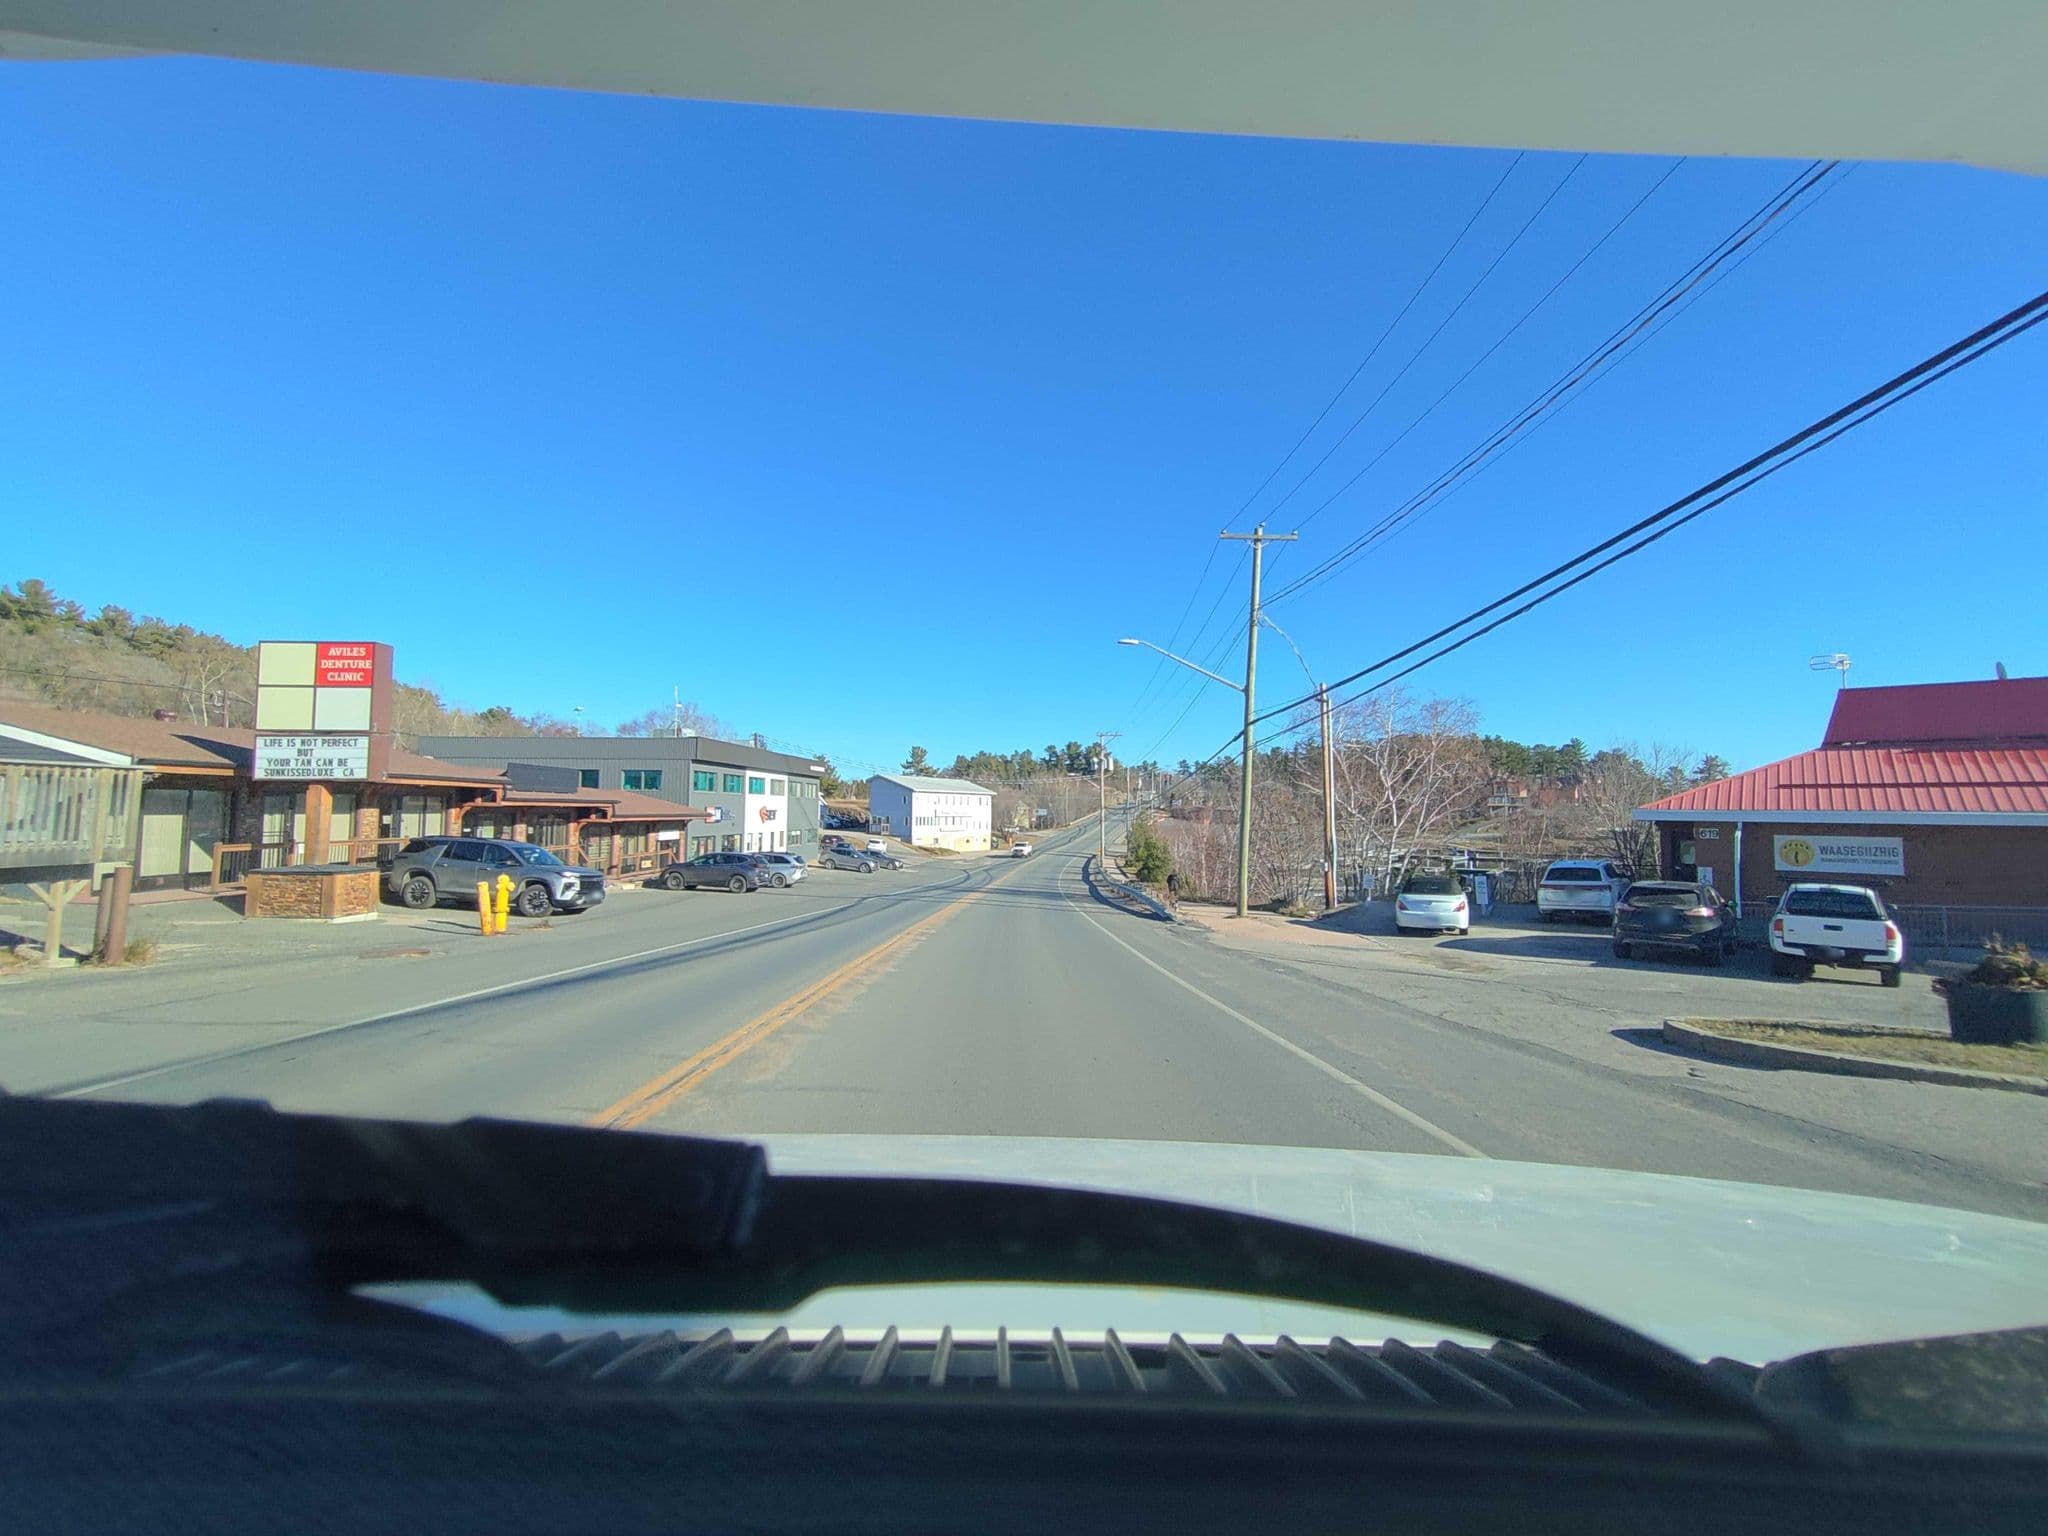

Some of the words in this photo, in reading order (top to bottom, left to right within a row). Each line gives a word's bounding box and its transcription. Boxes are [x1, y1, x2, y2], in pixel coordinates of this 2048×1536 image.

[328, 647, 366, 657] AVILES
[320, 660, 372, 669] DENTURE
[327, 672, 365, 681] CLINIC
[264, 738, 283, 747] LIFE
[287, 738, 296, 747] IS
[300, 738, 318, 747] NOT
[321, 738, 358, 747] PERFECT
[297, 748, 314, 757] BUT
[267, 758, 291, 767] YOUR
[295, 758, 312, 767] TAN
[315, 758, 333, 767] CAN
[337, 758, 349, 767] BE
[264, 768, 334, 777] SUNKISSEDLUXE
[342, 768, 354, 777] CA
[1700, 829, 1719, 838] 619
